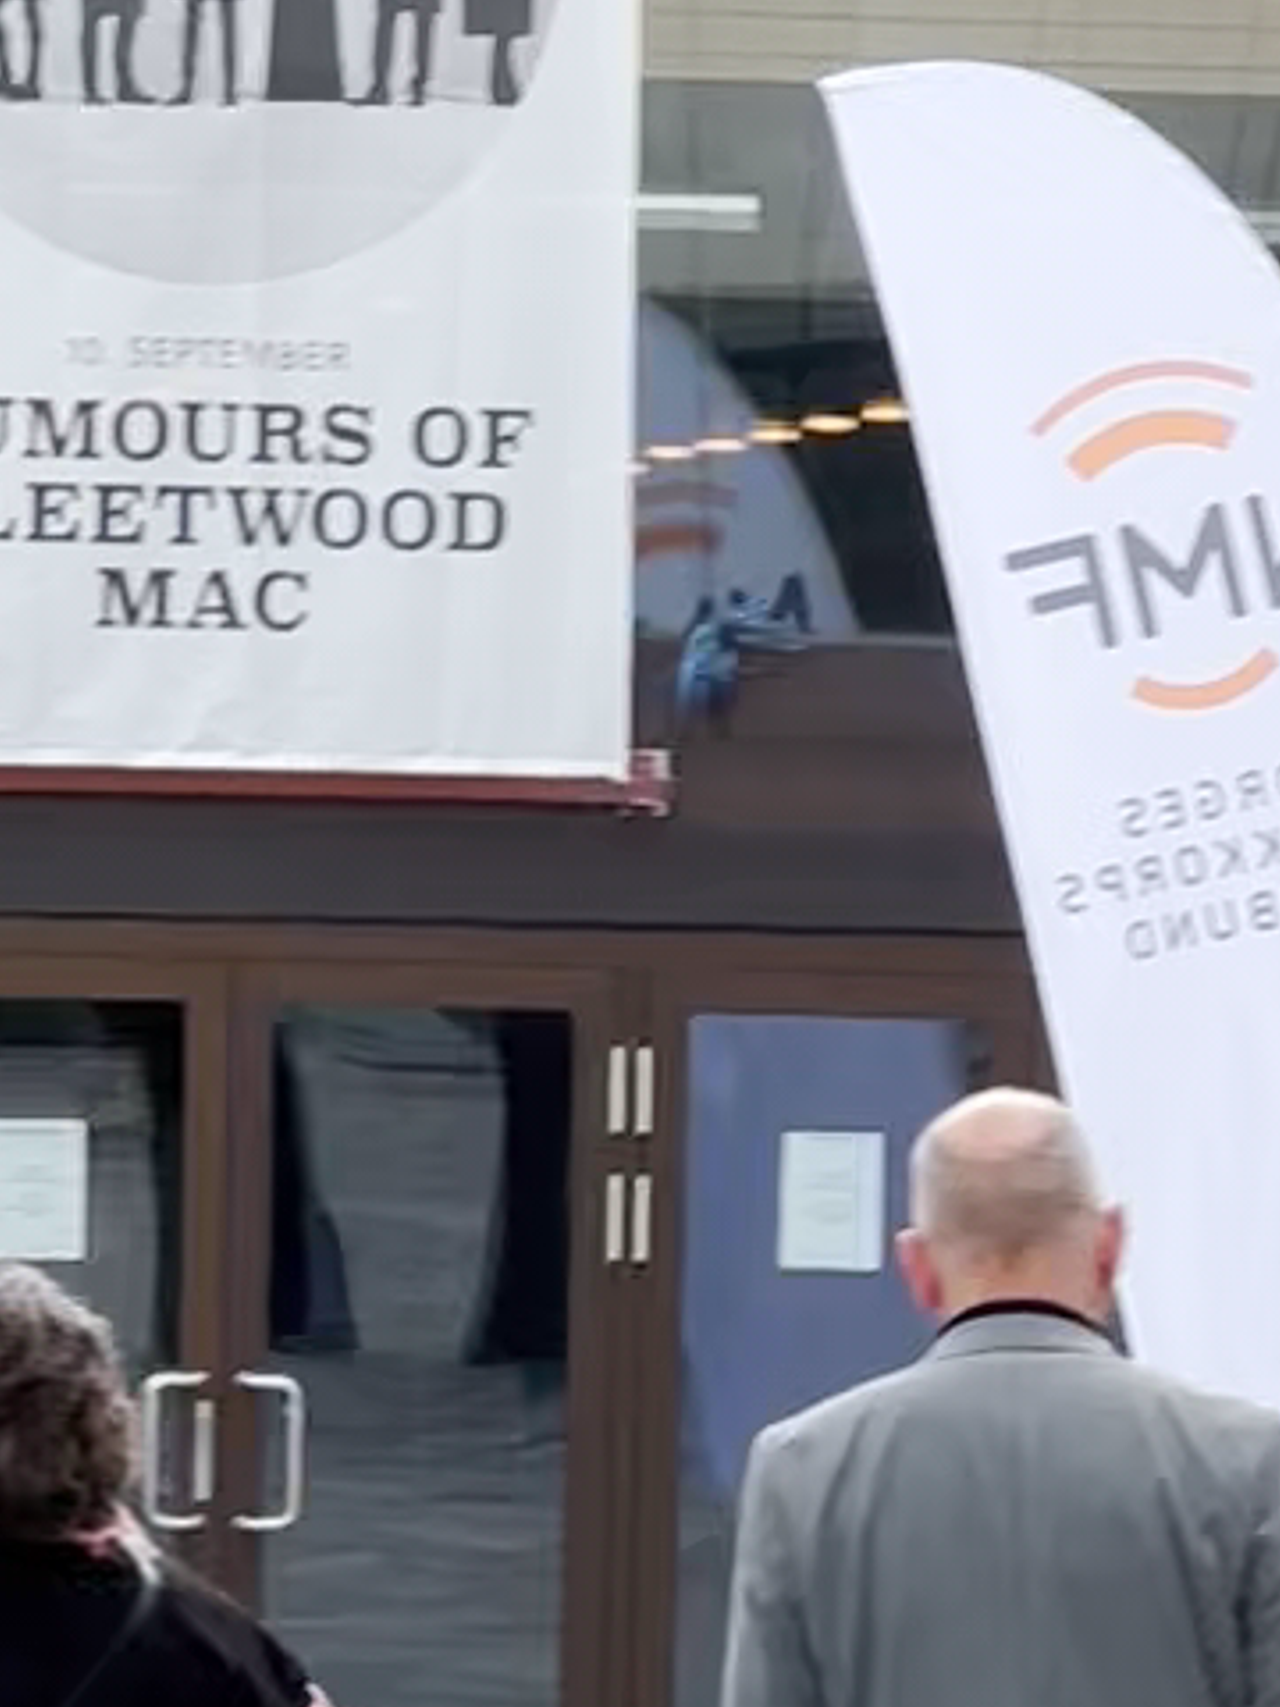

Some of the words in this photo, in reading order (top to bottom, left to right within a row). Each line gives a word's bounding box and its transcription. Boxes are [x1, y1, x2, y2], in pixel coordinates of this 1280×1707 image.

[126, 338, 349, 370] SEPTEMBER
[410, 408, 535, 468] OF
[94, 568, 311, 632] MAC
